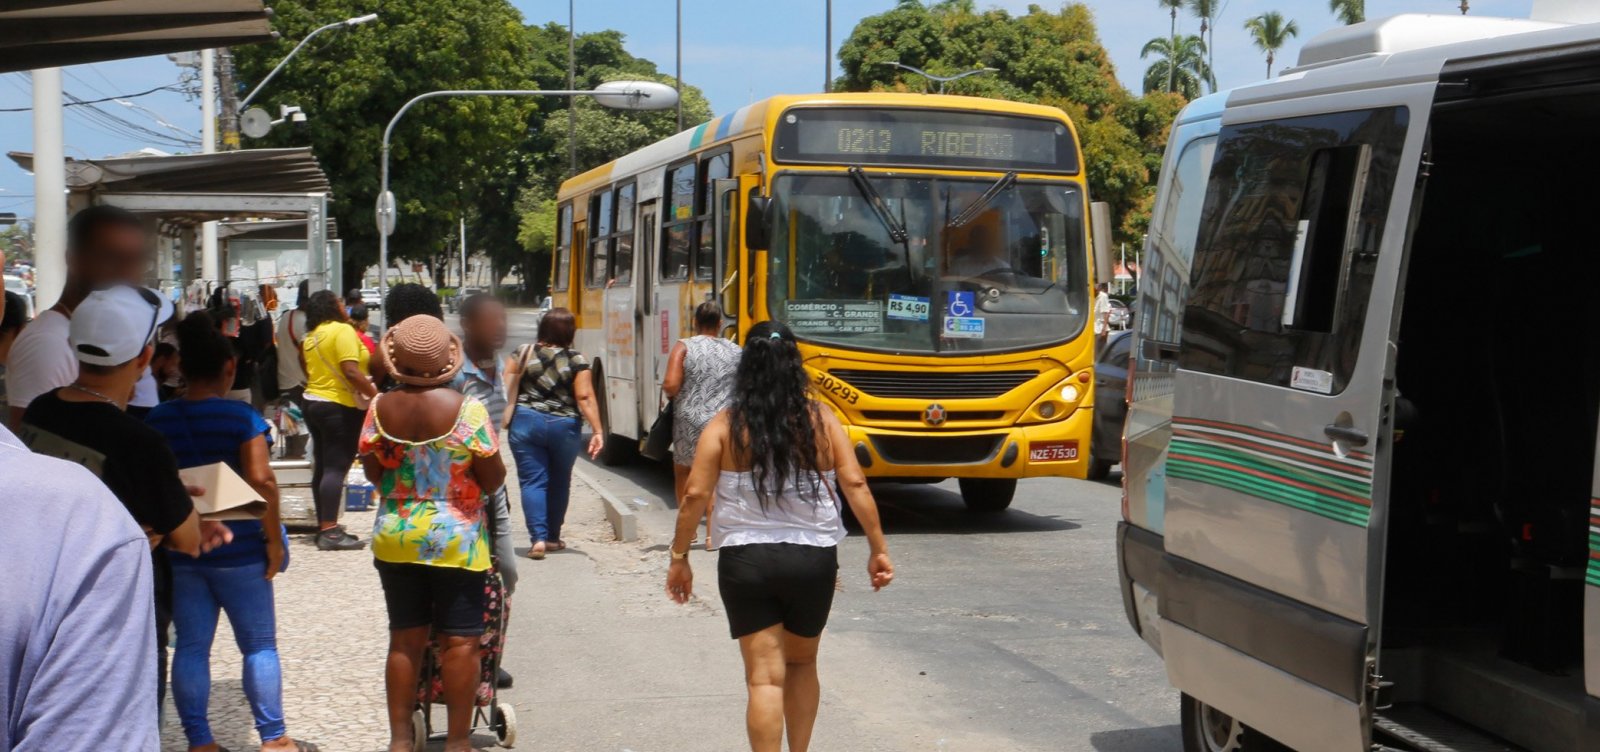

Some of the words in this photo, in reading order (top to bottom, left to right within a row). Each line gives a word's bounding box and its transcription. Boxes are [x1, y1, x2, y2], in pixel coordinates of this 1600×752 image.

[837, 128, 891, 153] 0213
[787, 302, 836, 311] COMÉRCIO
[890, 301, 903, 311] R$
[905, 303, 926, 313] 4,90
[814, 372, 859, 405] 30293
